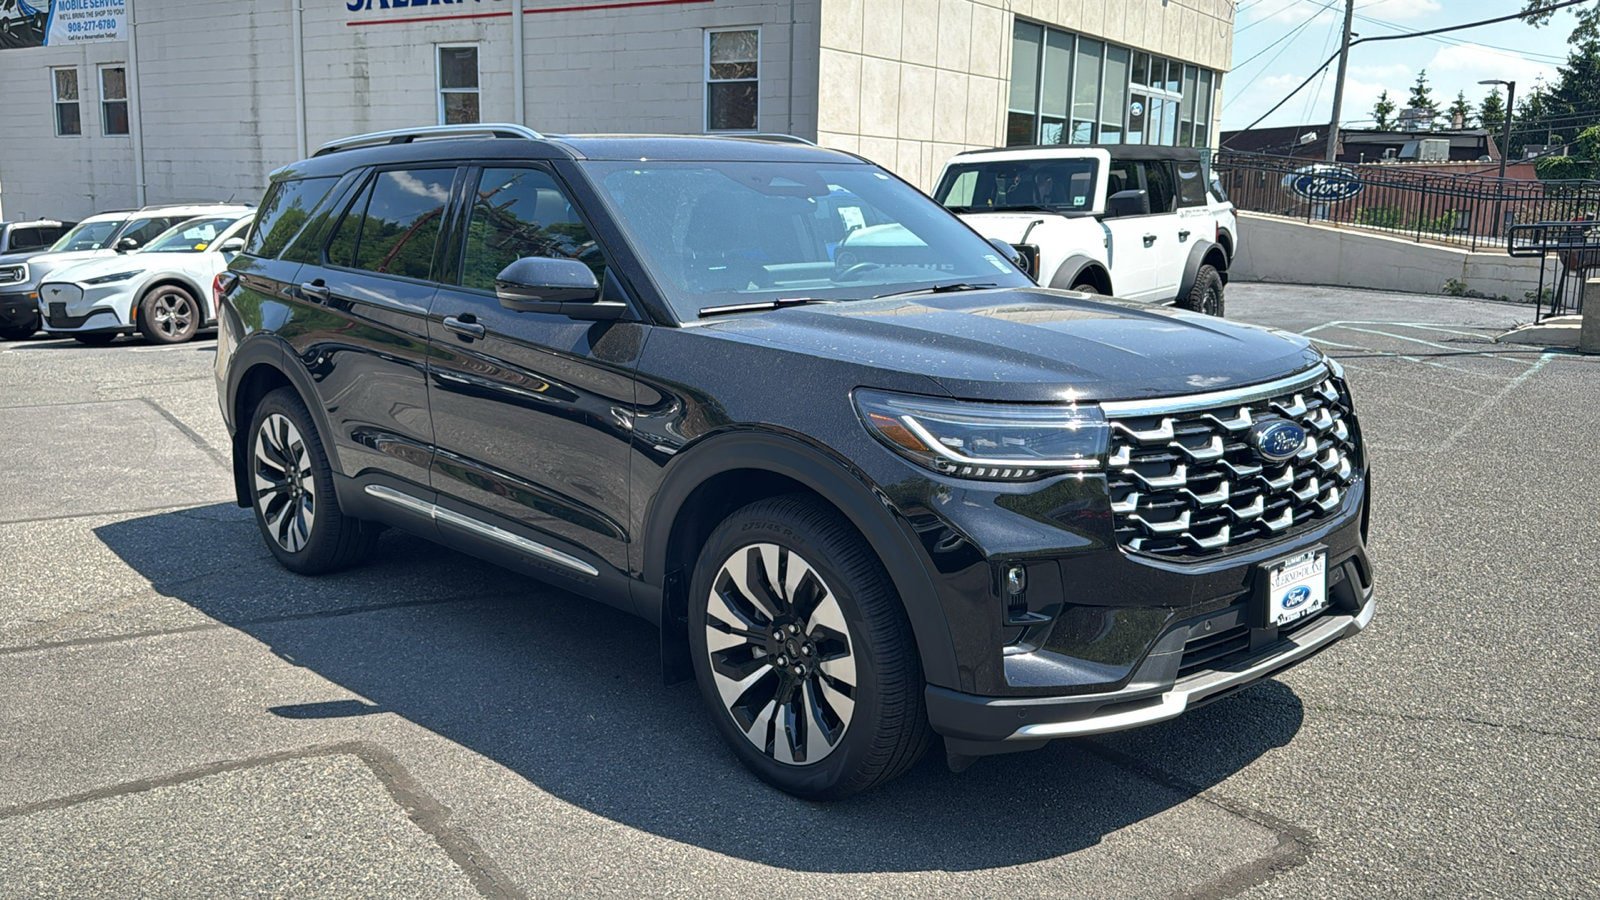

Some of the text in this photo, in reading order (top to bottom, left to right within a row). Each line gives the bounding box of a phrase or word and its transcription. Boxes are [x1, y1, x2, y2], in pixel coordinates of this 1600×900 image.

[59, 0, 124, 11] MOBILE SERVICE
[68, 19, 116, 32] 908-277-6780
[1273, 430, 1299, 451] Ford
[1286, 587, 1306, 607] Ford
